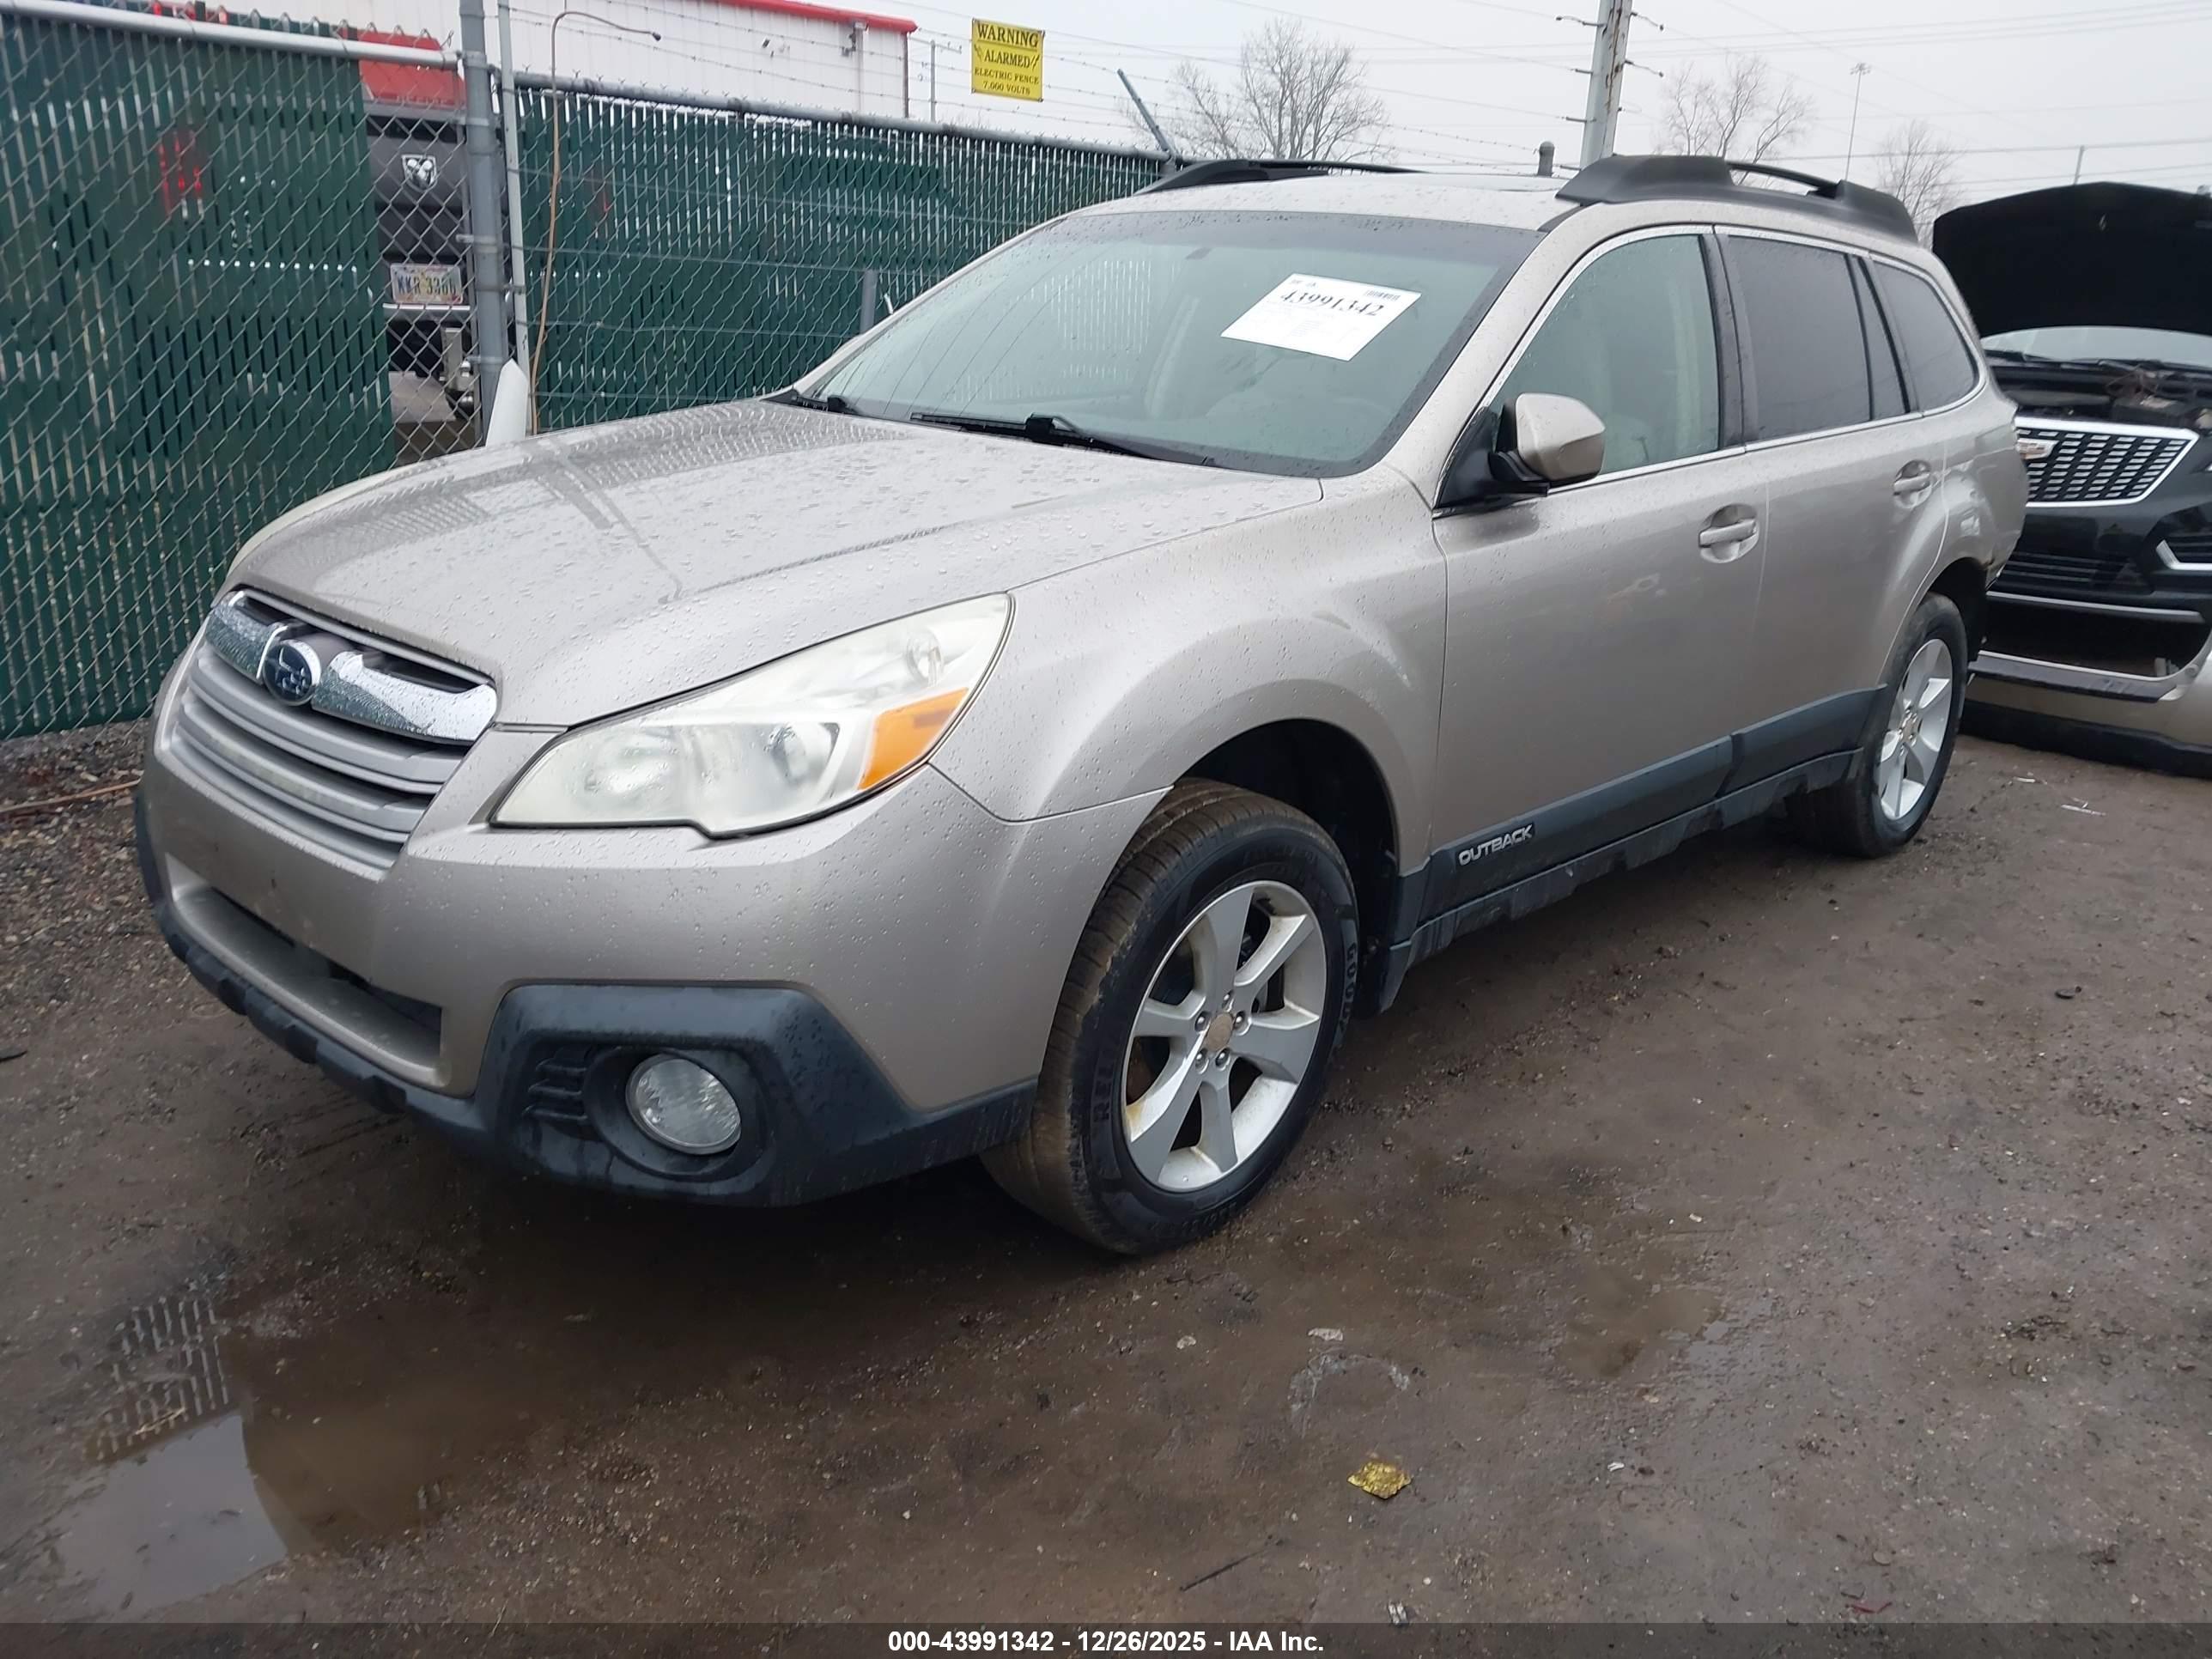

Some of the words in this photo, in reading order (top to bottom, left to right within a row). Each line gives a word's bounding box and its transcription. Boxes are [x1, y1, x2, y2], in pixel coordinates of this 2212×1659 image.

[977, 22, 1039, 48] WARNING
[984, 49, 1030, 68] ALARMED
[975, 67, 1012, 82] ELECTRIC
[1014, 72, 1039, 85] FENCE
[1006, 85, 1030, 95] VOLTS
[1280, 289, 1385, 317] 43991342
[1458, 823, 1533, 866] OUTBACK
